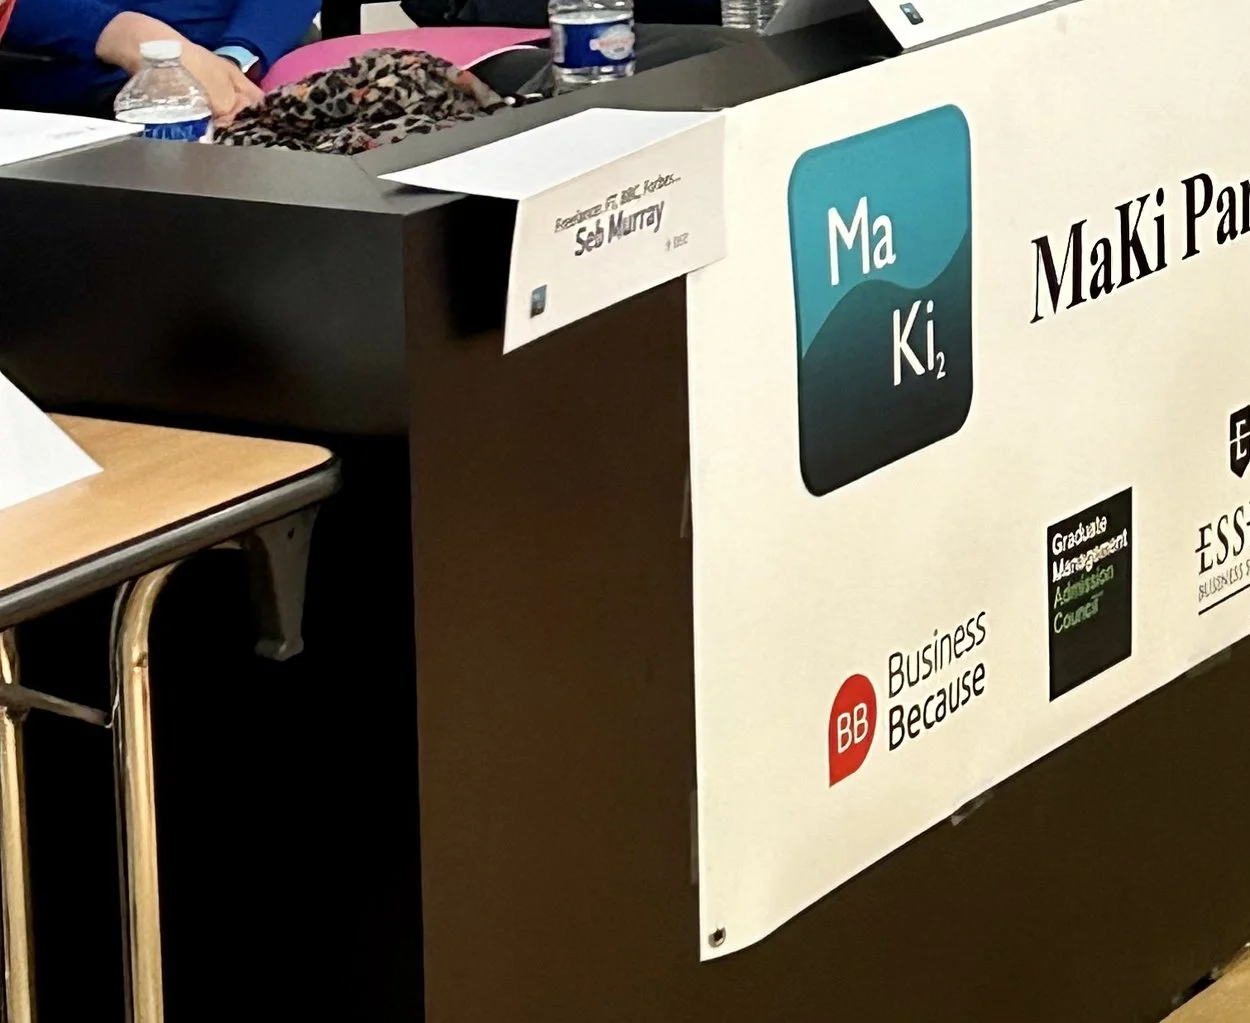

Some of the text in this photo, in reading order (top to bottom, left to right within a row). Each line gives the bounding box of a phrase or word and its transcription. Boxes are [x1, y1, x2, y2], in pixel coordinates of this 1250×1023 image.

[574, 219, 604, 257] Seb
[607, 200, 665, 244] Murray
[827, 195, 897, 287] Ma
[1030, 187, 1168, 324] MaKi
[1051, 515, 1108, 556] Graduate
[1052, 528, 1129, 583] Management
[1053, 563, 1115, 610] Admission
[1053, 590, 1105, 634] Council
[888, 610, 987, 699] Business
[837, 702, 869, 754] BB
[888, 662, 986, 752] Because
